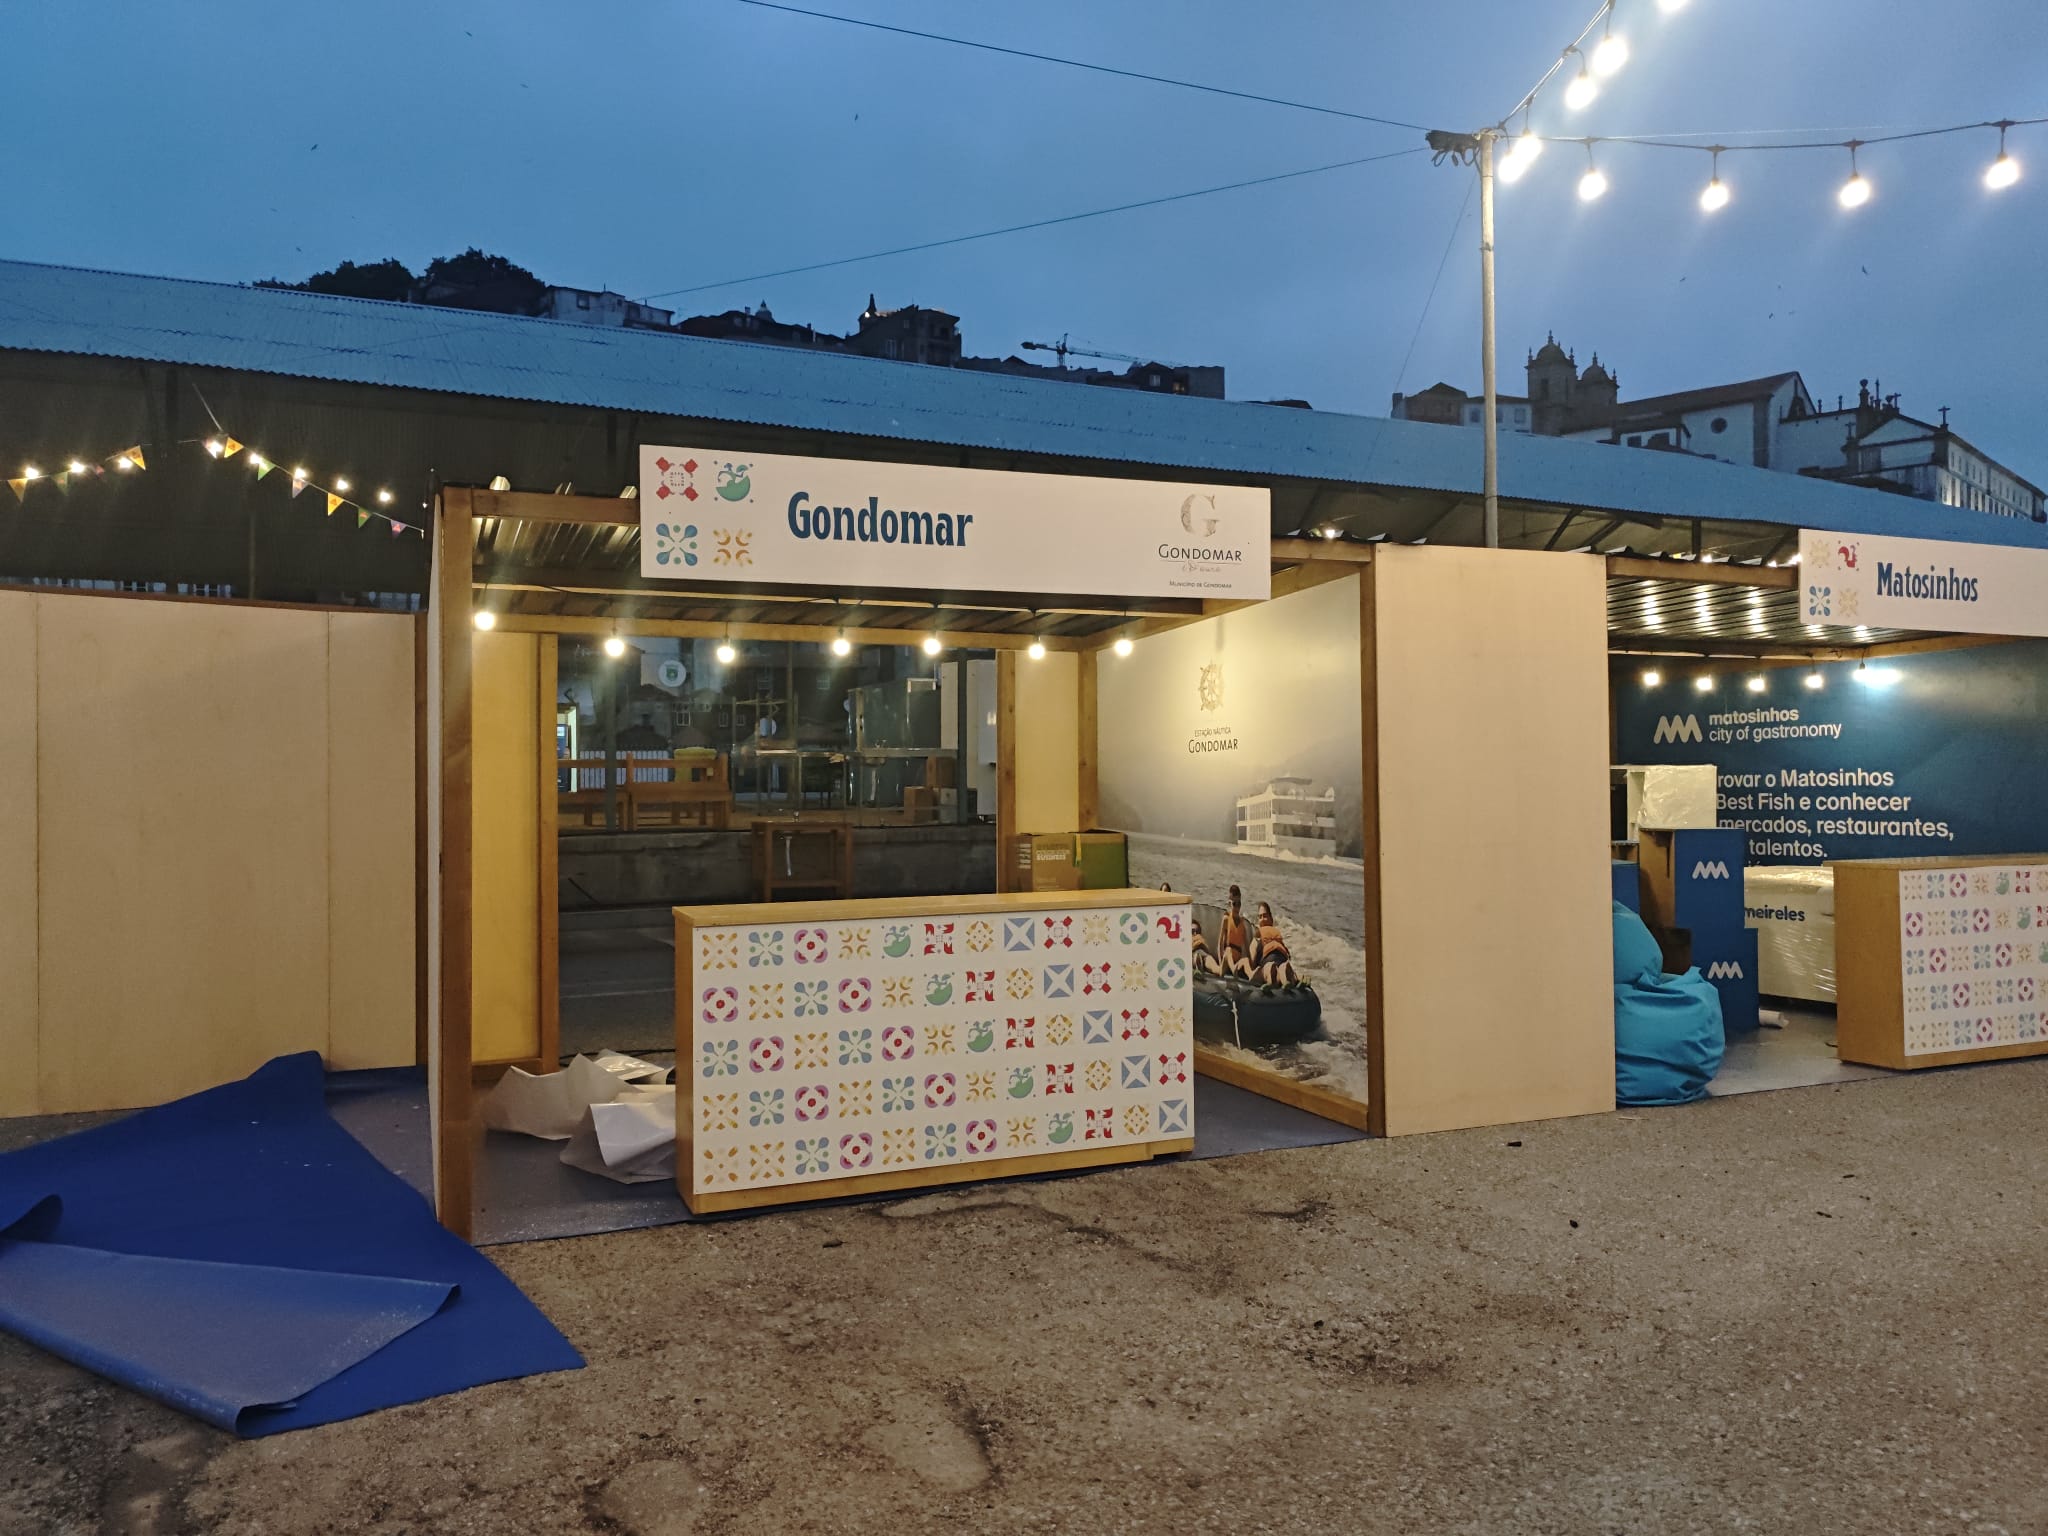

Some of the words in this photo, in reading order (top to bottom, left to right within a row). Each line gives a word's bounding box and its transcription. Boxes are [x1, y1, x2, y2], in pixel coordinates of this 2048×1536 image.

[788, 491, 974, 547] Gondomar
[1158, 543, 1242, 562] GONDOMAR
[1877, 561, 1978, 602] Matosinhos
[1709, 707, 1799, 726] matosinhos
[1709, 727, 1733, 744] city
[1736, 725, 1750, 741] of
[1752, 723, 1842, 743] gastronomy
[1188, 738, 1238, 754] GONDOMAR
[1717, 774, 1761, 788] rovar
[1764, 773, 1777, 788] o
[1780, 767, 1895, 788] Matosinhos
[1716, 793, 1754, 810] Best
[1758, 792, 1795, 811] Fish
[1799, 796, 1811, 811] e
[1815, 792, 1912, 812] conhecer
[1719, 815, 1812, 838] mercados,
[1816, 818, 1955, 842] restaurantes,
[1749, 838, 1828, 858] talentos.
[1744, 904, 1806, 922] meireles
